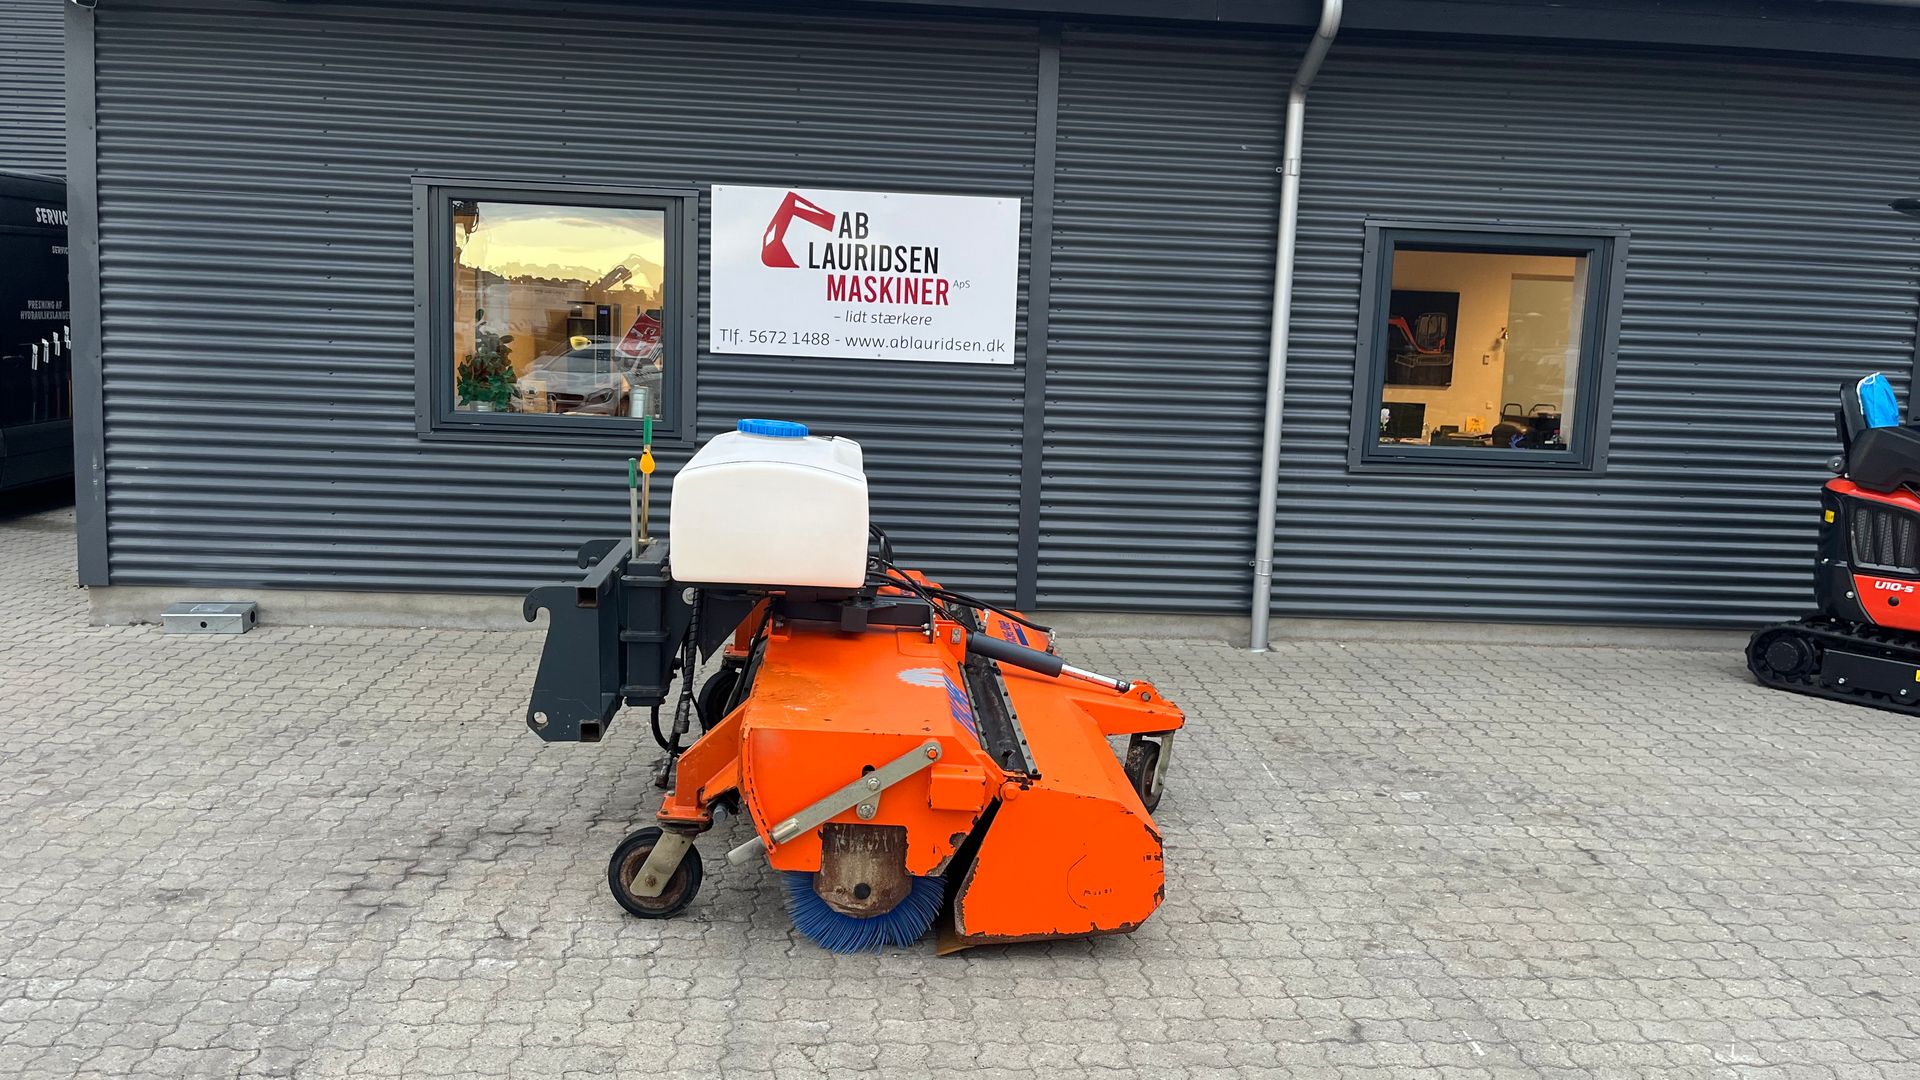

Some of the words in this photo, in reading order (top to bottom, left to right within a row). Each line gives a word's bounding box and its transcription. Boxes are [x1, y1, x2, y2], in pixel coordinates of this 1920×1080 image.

[838, 211, 869, 240] AB
[808, 241, 939, 275] LAURIDSEN
[826, 273, 950, 306] MASKINER
[952, 278, 972, 290] ApS
[55, 300, 63, 310] AF
[844, 309, 869, 325] lidt
[870, 312, 933, 327] stærkere
[719, 328, 744, 346] Tlf.
[748, 329, 788, 345] 5672
[791, 331, 831, 346] 1488
[844, 335, 1006, 354] www.ablauridsen.dk
